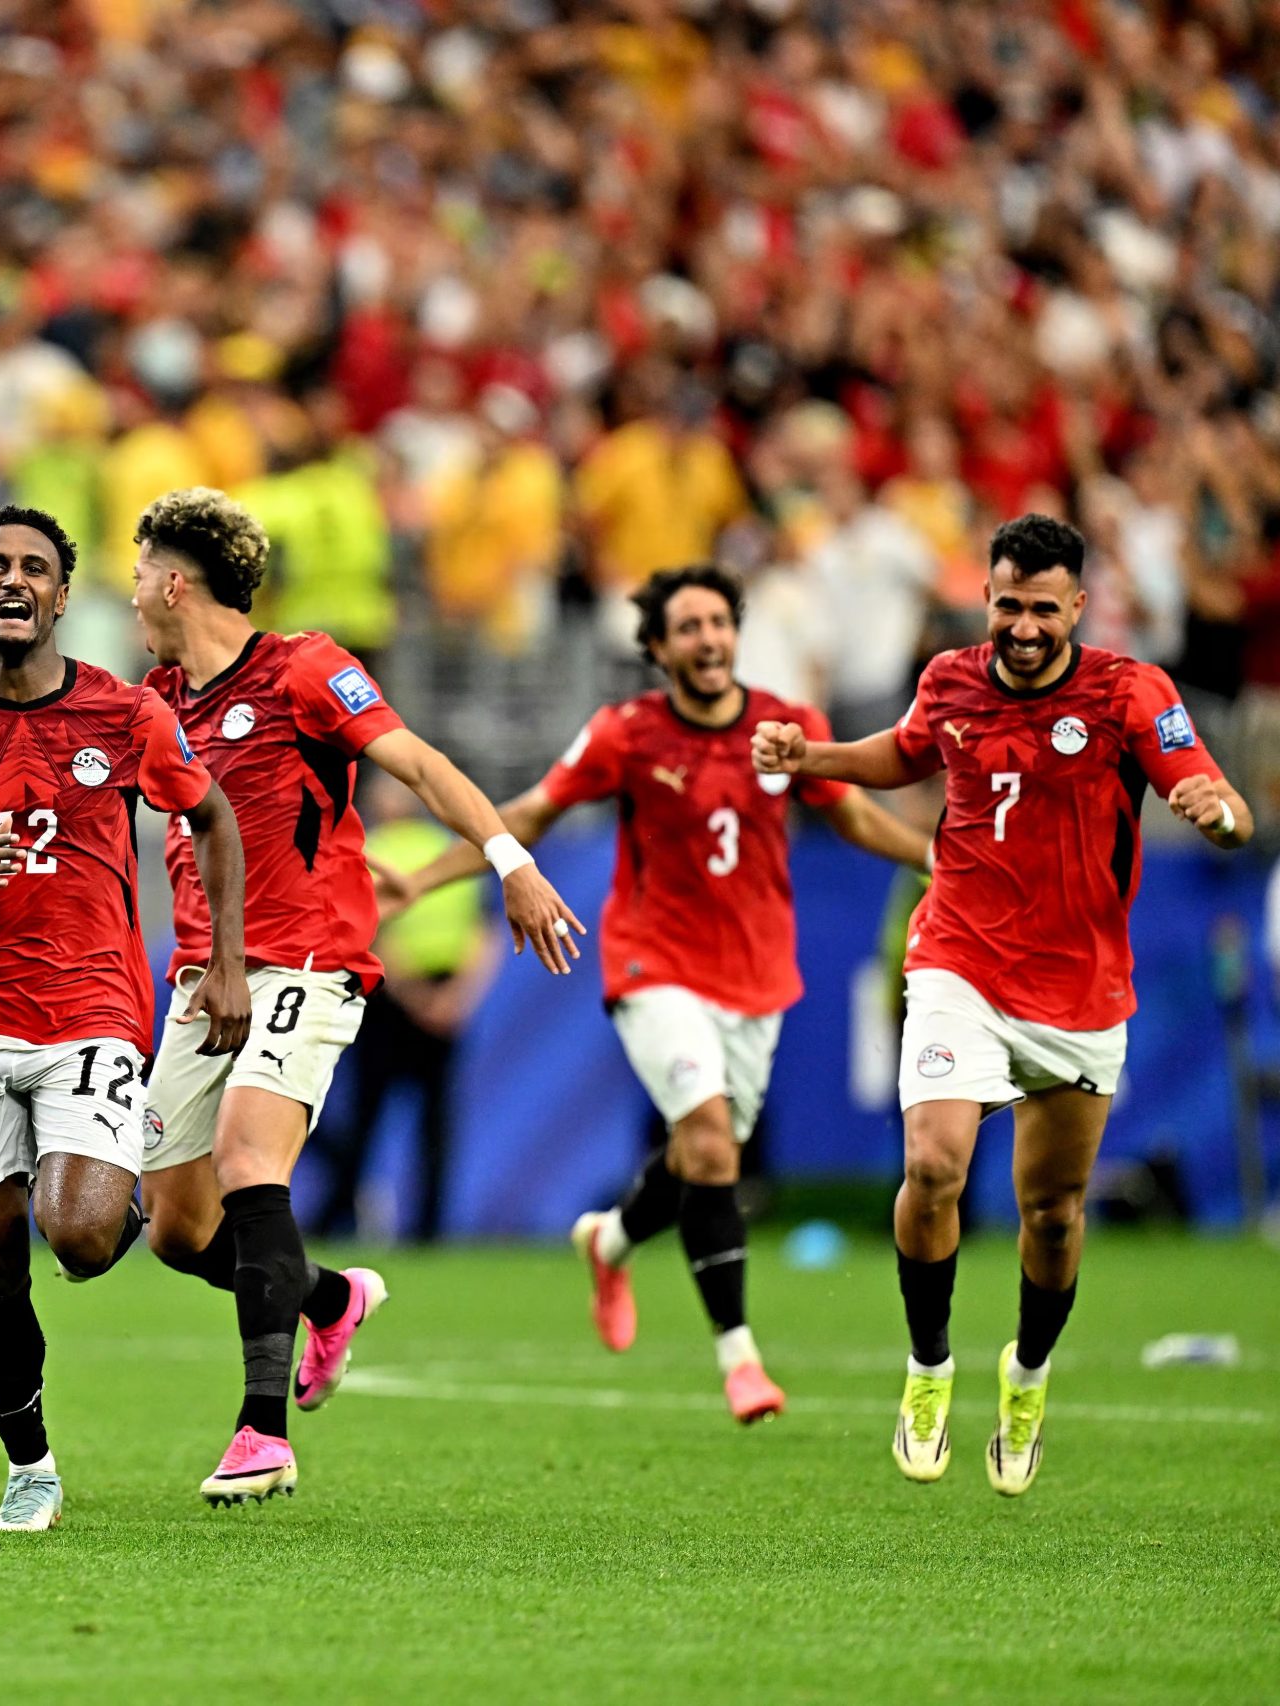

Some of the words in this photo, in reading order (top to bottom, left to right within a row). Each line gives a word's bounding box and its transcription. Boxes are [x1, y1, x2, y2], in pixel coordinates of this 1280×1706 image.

[991, 772, 1021, 842] 7
[706, 808, 740, 877] 3
[265, 986, 307, 1034] 8
[71, 1045, 134, 1110] 12
